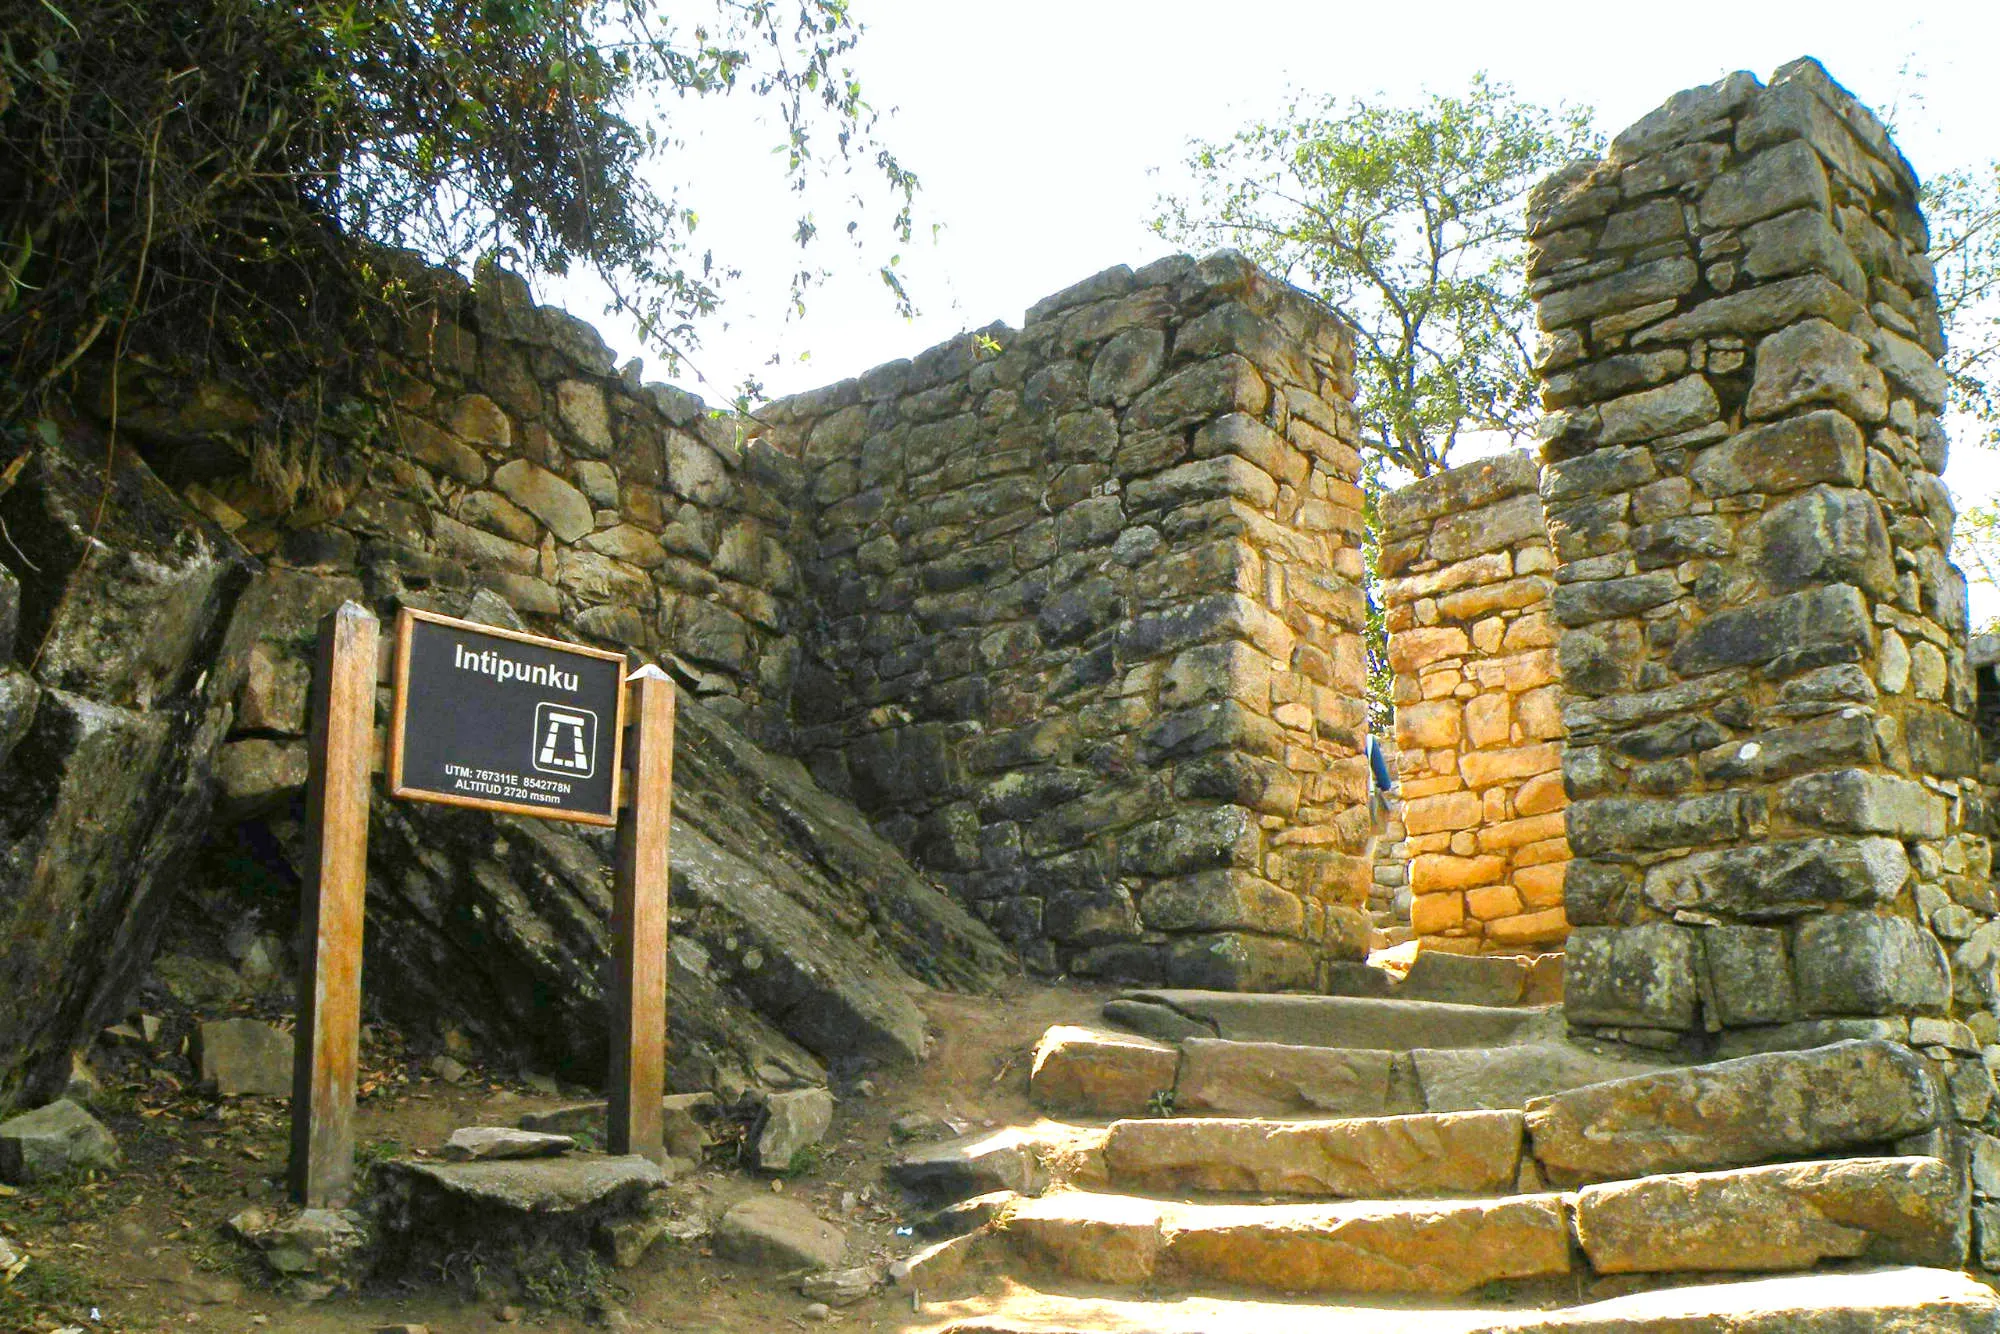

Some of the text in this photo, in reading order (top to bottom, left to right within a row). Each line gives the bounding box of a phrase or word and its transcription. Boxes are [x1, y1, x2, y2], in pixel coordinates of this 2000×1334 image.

[455, 644, 578, 692] Intipunku
[445, 764, 571, 794] UTM: 767311E 8542778N
[455, 779, 560, 804] ALTITUD 2720 msnm
